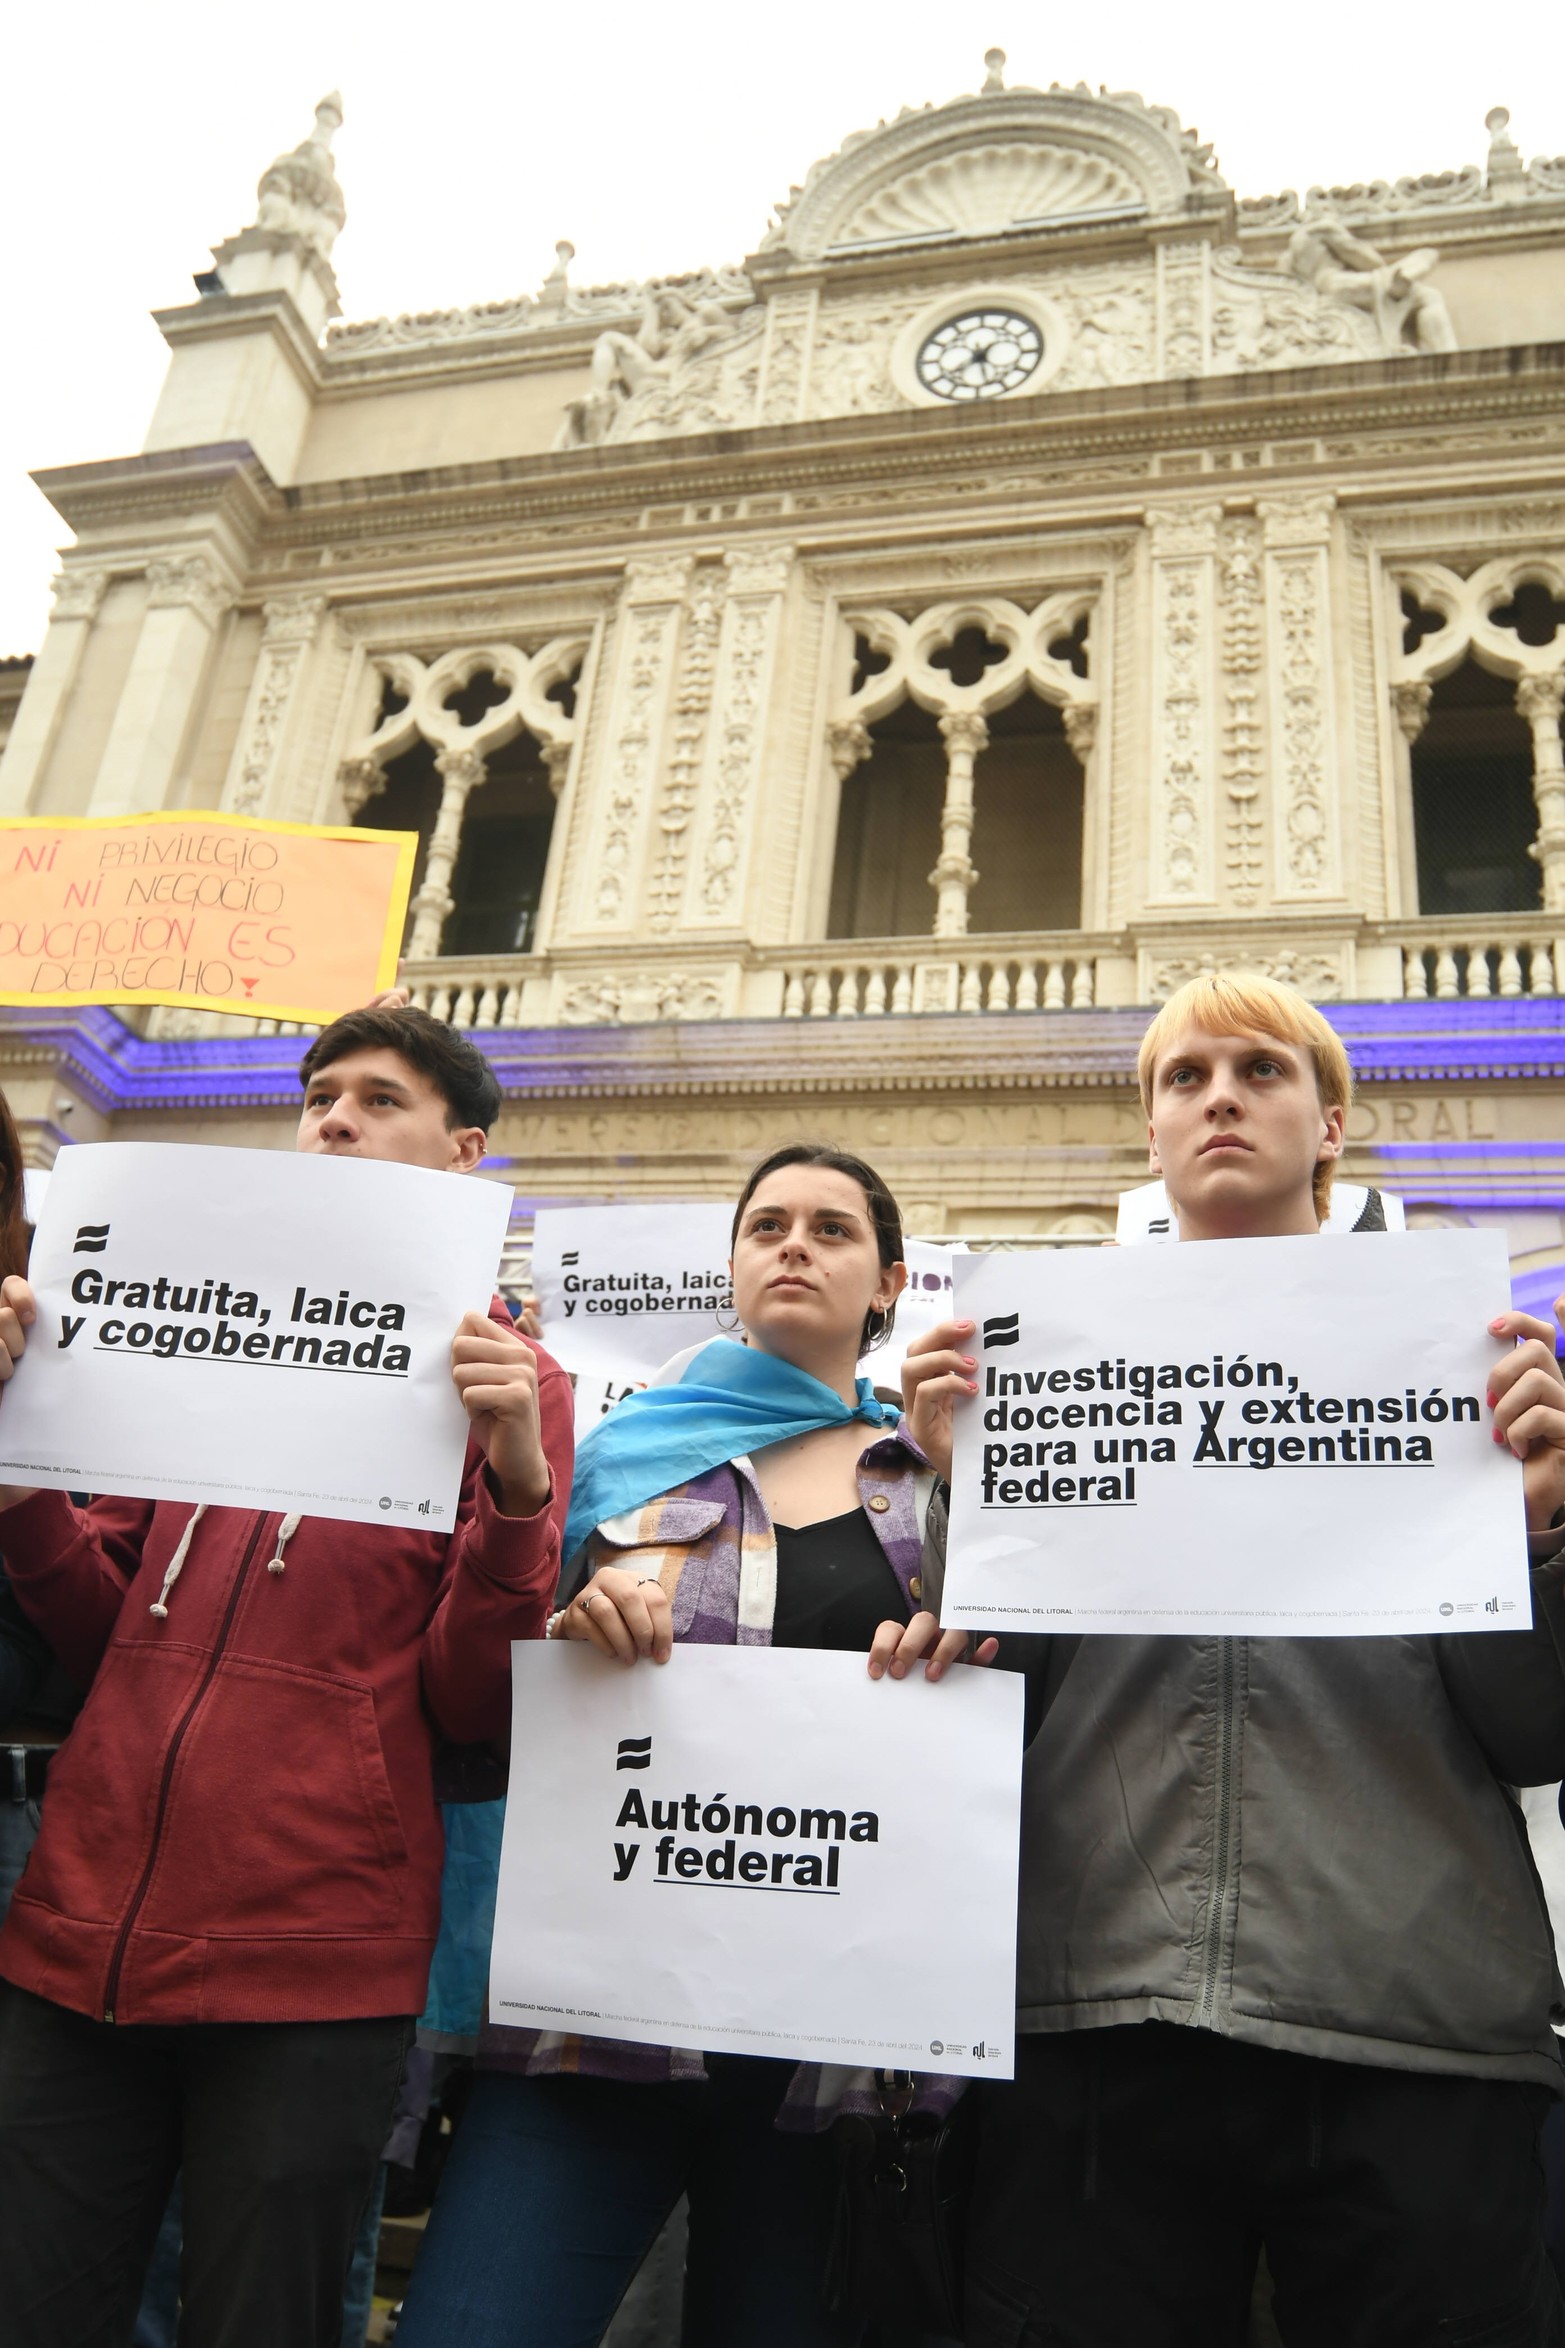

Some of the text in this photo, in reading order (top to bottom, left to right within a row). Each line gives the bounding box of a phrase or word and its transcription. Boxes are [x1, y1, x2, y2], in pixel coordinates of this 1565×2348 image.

[14, 833, 279, 876] NI PRIVILEGIO
[63, 873, 284, 914] NI NEGOCIO
[228, 921, 296, 968] ES
[1345, 1099, 1494, 1142] ORAL
[71, 1269, 406, 1331] Gratuita, laica
[563, 1272, 672, 1293] Gratuita,
[564, 1291, 734, 1317] y cogobernad
[58, 1315, 412, 1371] y cogobernada
[985, 1354, 1299, 1400] Investigación,
[983, 1388, 1481, 1432] docencia y extensión
[30, 1463, 52, 1472] NACIONAL
[62, 1466, 81, 1475] LITORAL
[983, 1427, 1433, 1475] para una Argentina
[981, 1466, 1135, 1504] federal
[615, 1788, 879, 1842] Autónoma
[613, 1836, 840, 1887] y federal
[498, 2000, 535, 2010] UNIVERSIDAD
[536, 2004, 564, 2014] NACIONAL
[577, 2009, 602, 2019] LITORAL
